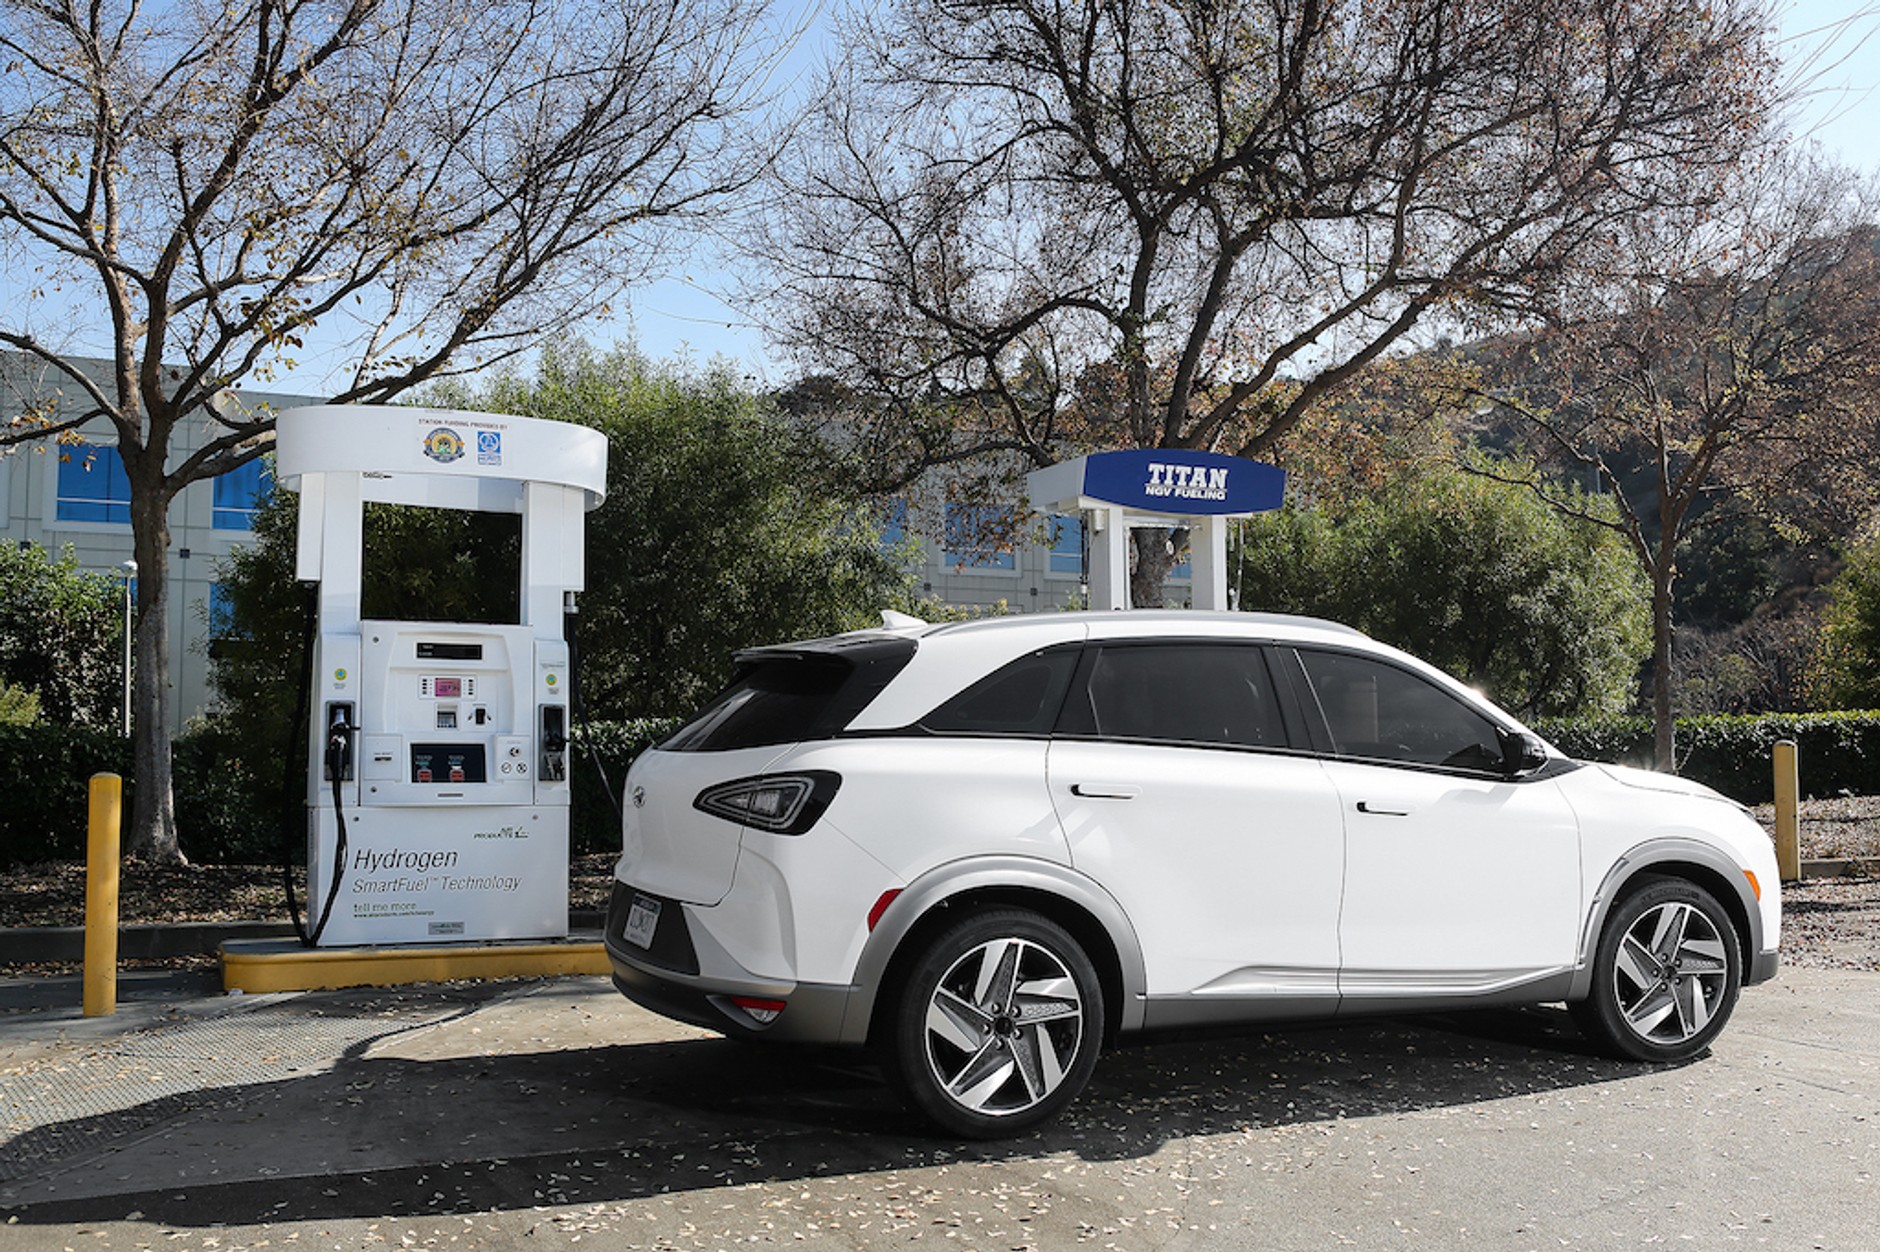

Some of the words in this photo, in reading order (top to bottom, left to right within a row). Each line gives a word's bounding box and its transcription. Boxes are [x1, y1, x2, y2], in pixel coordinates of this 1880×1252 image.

[1147, 463, 1228, 489] TITAN
[1145, 486, 1172, 497] NGV
[1174, 487, 1226, 500] FUELING
[353, 848, 459, 874] Hydrogen
[441, 875, 523, 892] Technology
[353, 903, 370, 912] tell
[373, 903, 388, 912] me
[391, 903, 416, 911] more
